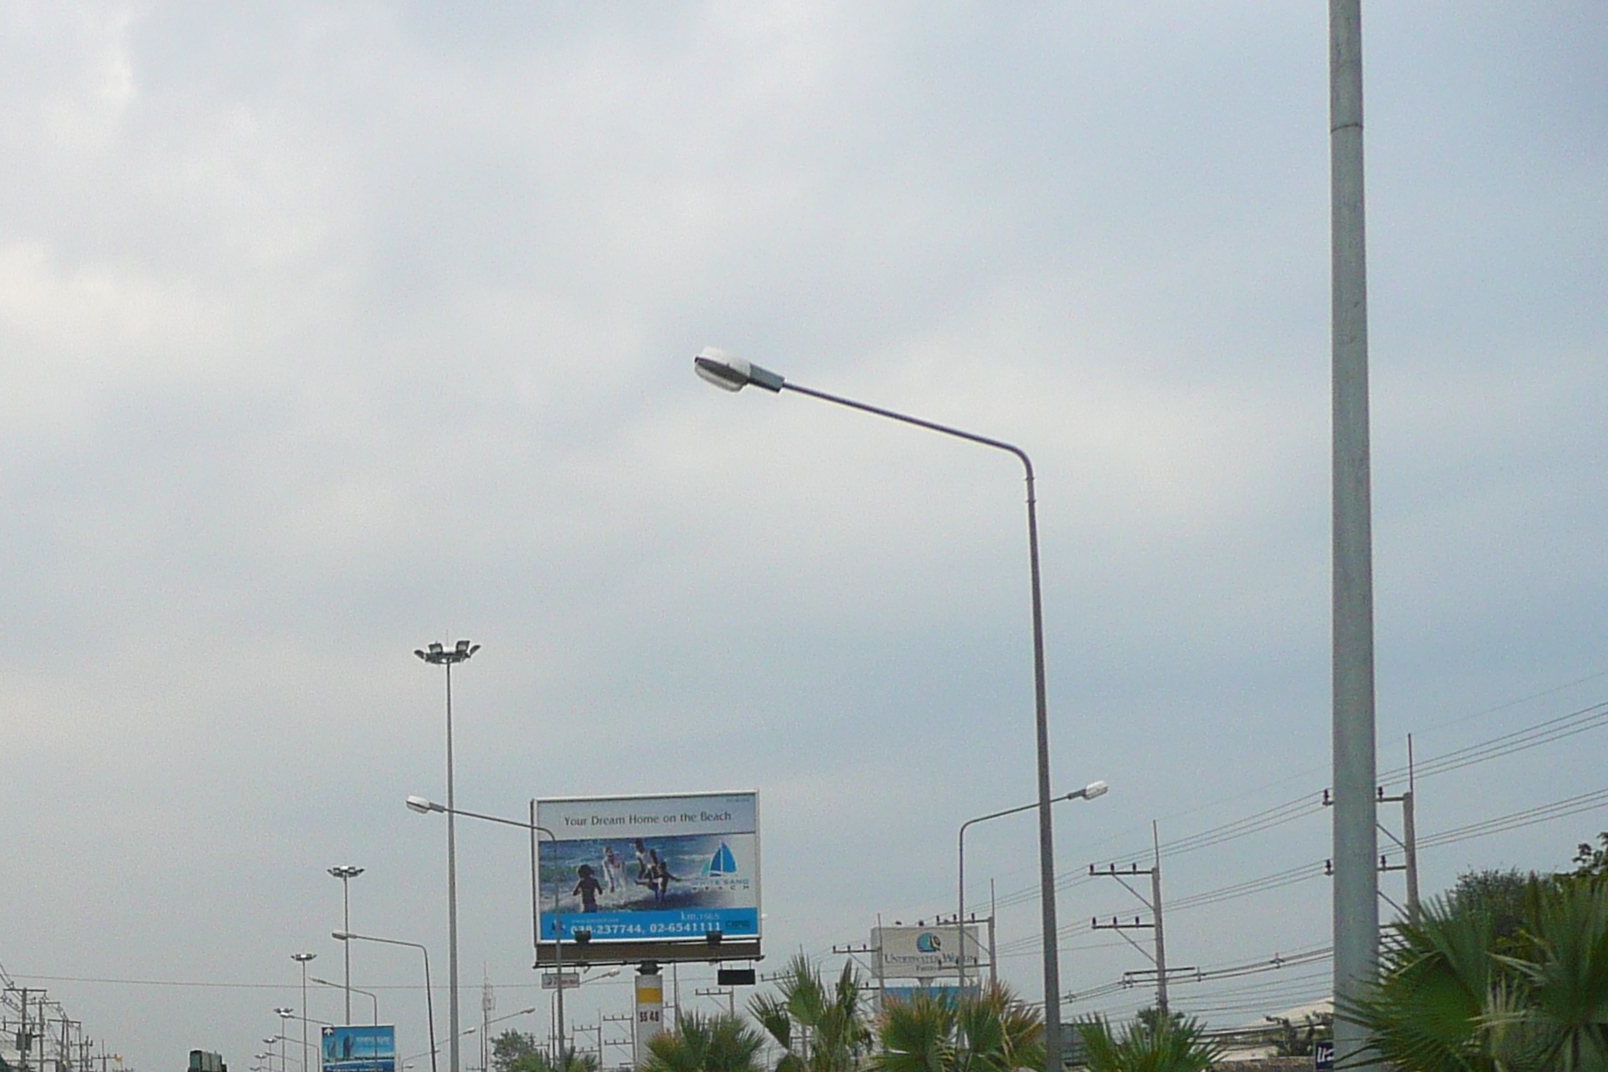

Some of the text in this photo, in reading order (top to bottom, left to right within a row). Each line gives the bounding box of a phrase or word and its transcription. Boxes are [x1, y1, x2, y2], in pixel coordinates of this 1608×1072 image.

[564, 810, 731, 826] Your Dream Home on the Beach
